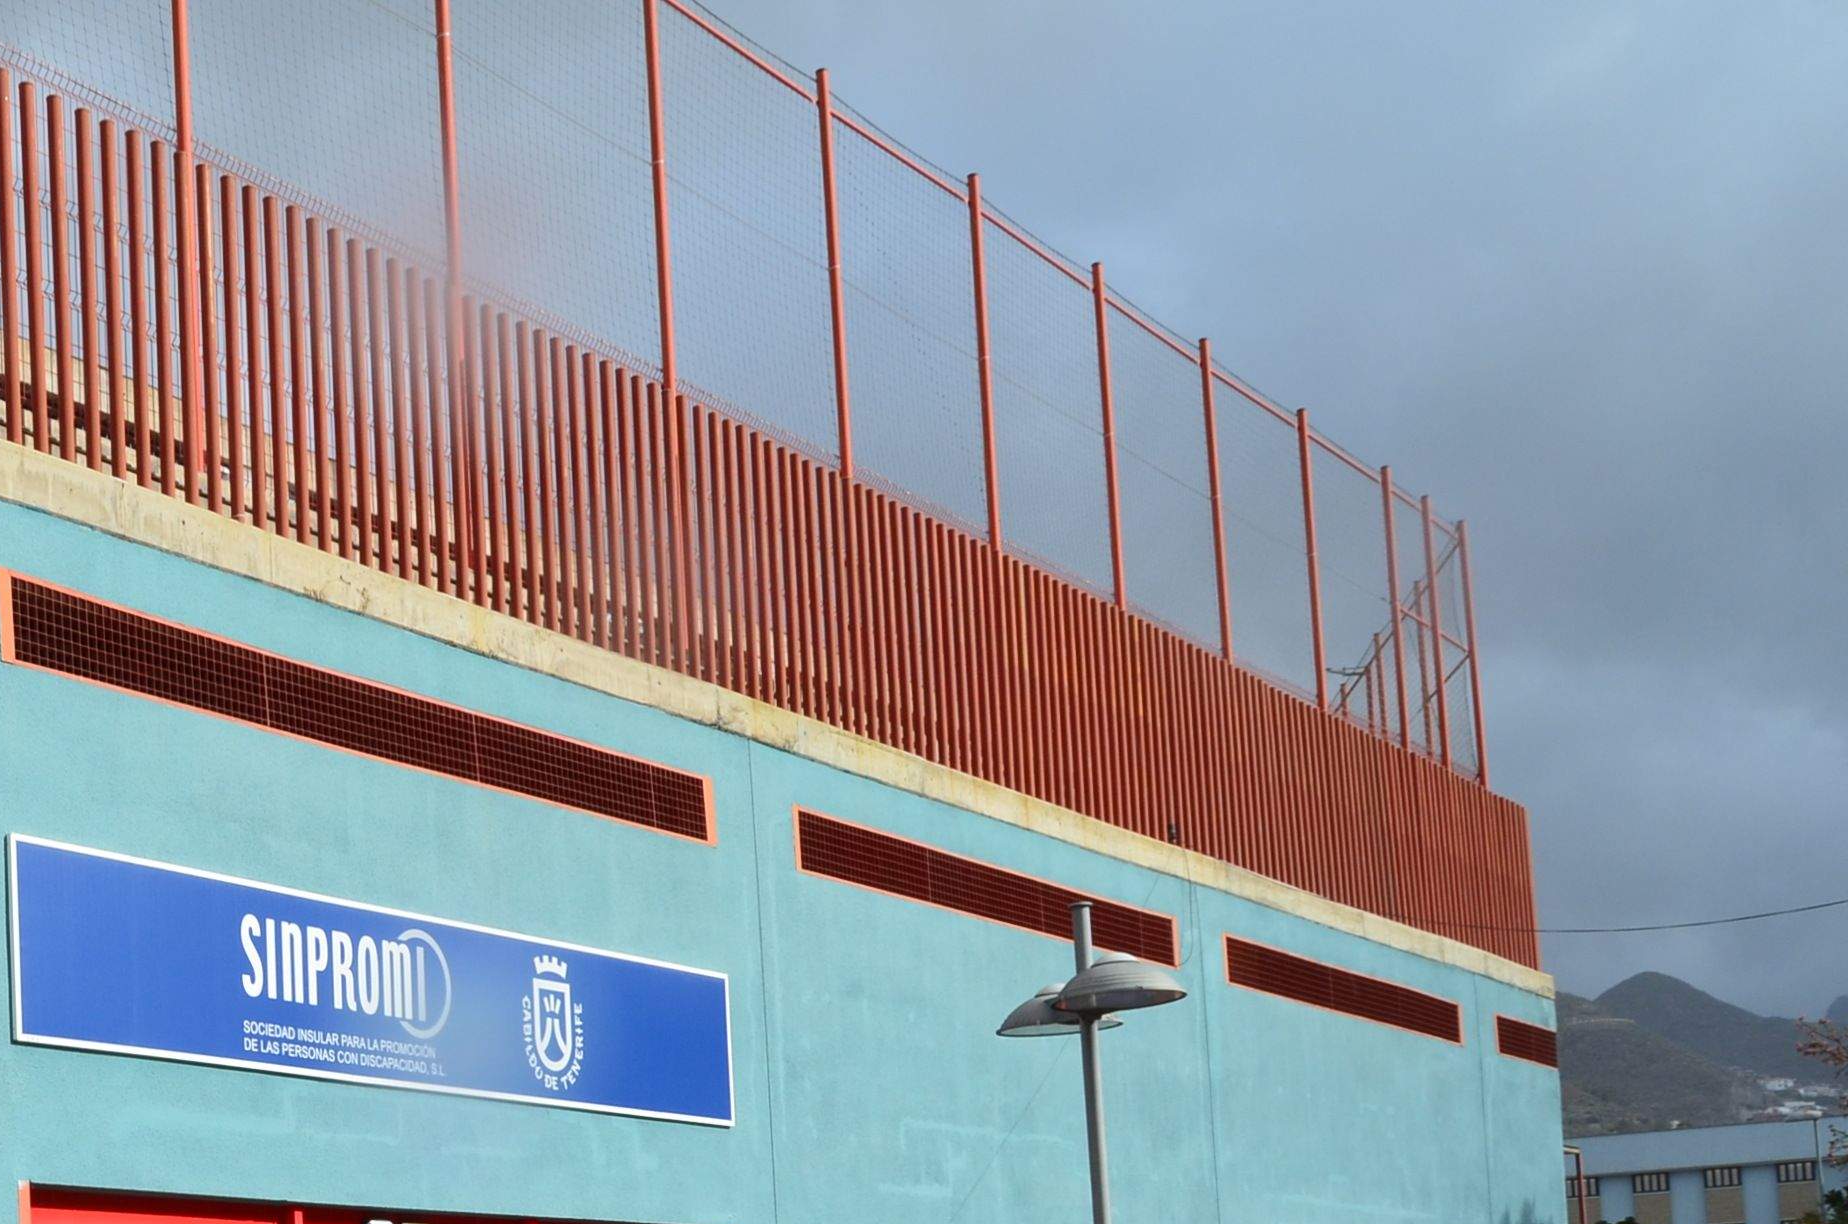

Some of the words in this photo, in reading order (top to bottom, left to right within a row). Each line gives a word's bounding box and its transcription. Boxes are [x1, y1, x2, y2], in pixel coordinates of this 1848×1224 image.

[240, 913, 427, 1022] SINPROMI
[243, 1019, 295, 1040] SOCIEDAD
[297, 1028, 340, 1047] INSULAR
[341, 1033, 366, 1050] PARA
[367, 1038, 380, 1051] LA
[244, 1036, 258, 1052] DE
[260, 1039, 280, 1055] LAS
[281, 1043, 336, 1063] PERSONAS
[337, 1050, 359, 1065] CON
[522, 995, 543, 1079] CABILDO
[544, 1074, 559, 1090] DE
[560, 1003, 584, 1090] TENERIFE
